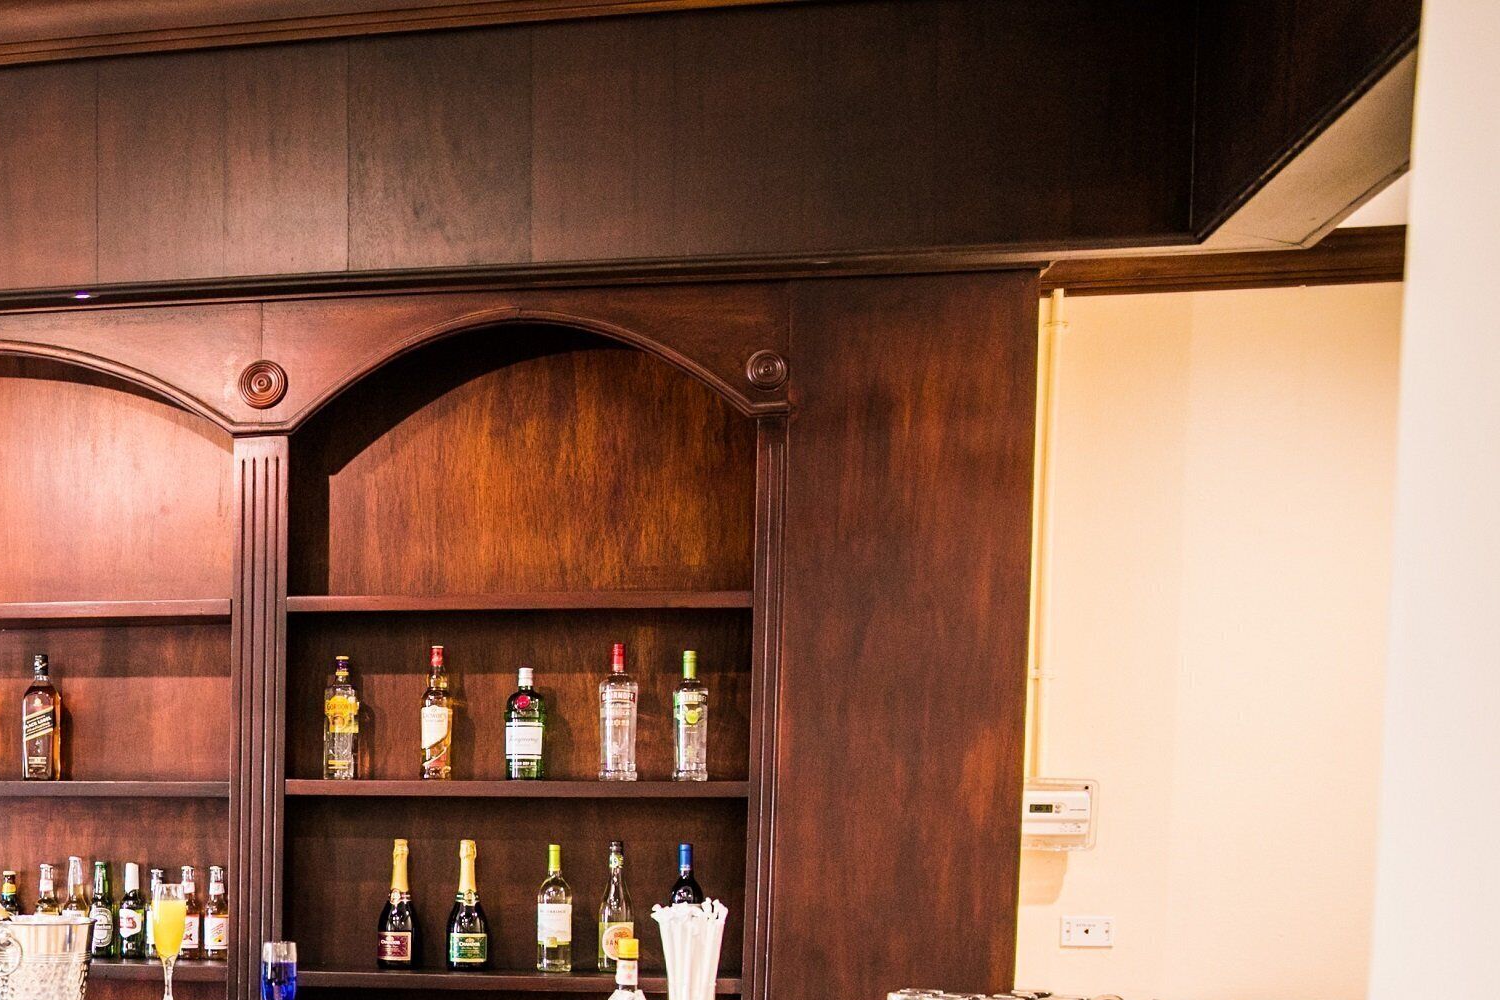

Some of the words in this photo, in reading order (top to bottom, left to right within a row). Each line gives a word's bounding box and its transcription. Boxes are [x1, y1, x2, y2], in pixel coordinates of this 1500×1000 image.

[602, 691, 635, 702] SIRNOFF
[676, 692, 708, 702] IRNOF
[326, 702, 354, 711] GORDON
